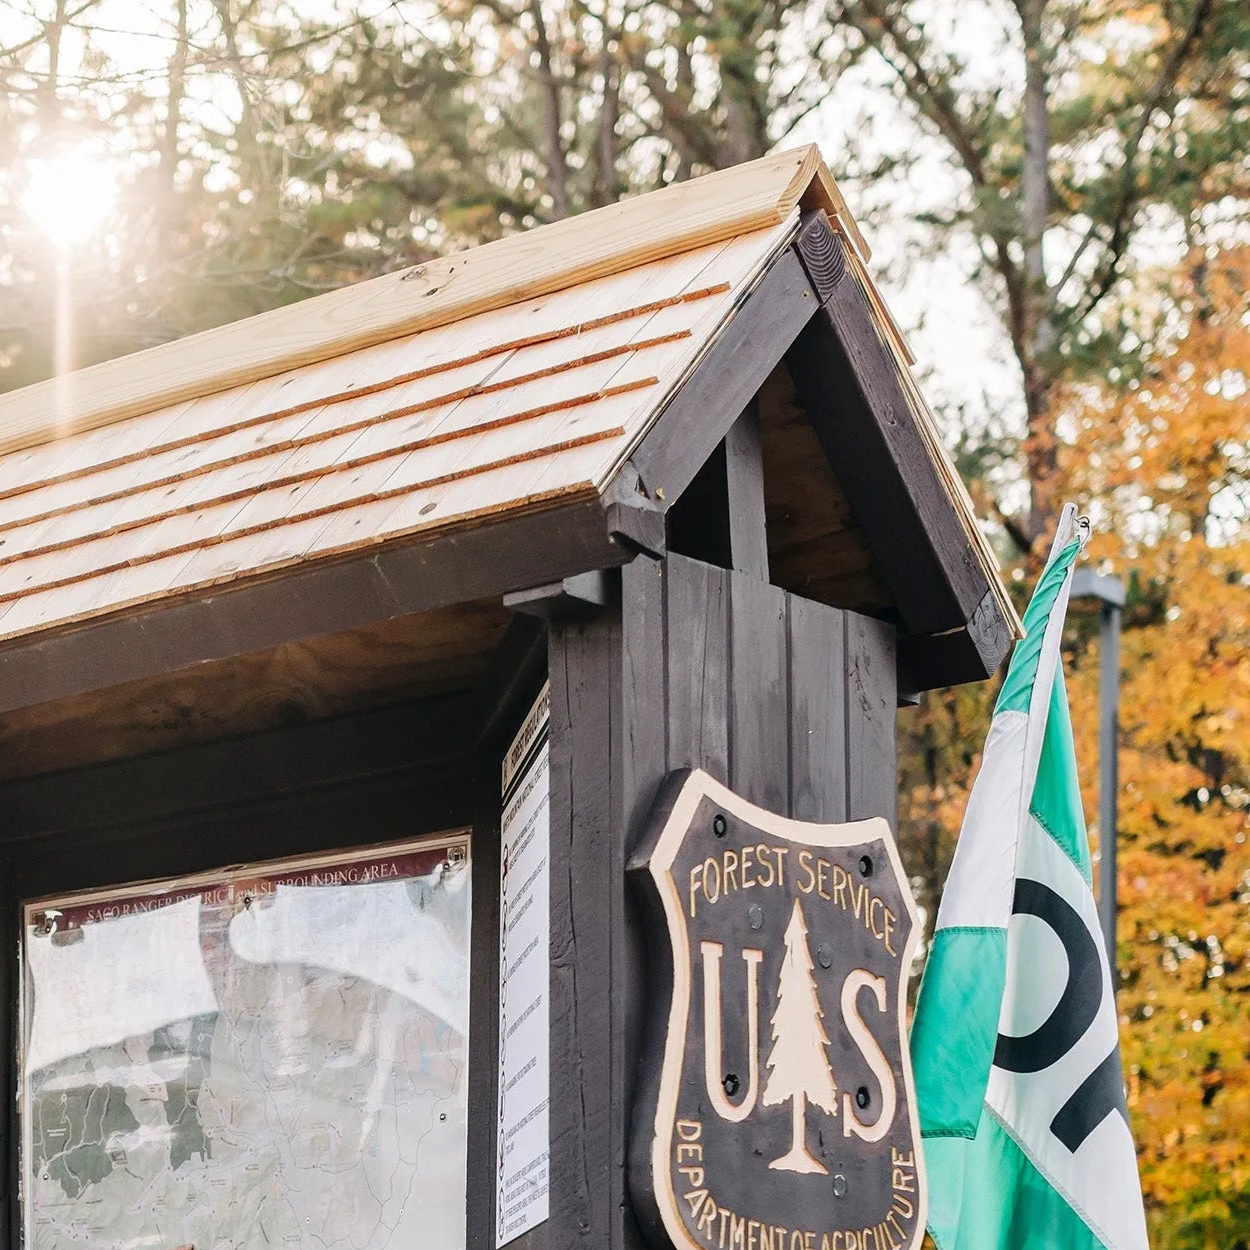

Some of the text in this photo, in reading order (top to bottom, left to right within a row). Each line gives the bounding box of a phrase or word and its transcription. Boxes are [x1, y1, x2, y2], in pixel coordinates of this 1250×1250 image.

[360, 864, 398, 881] AREA
[690, 845, 898, 957] FOREST SERVICE
